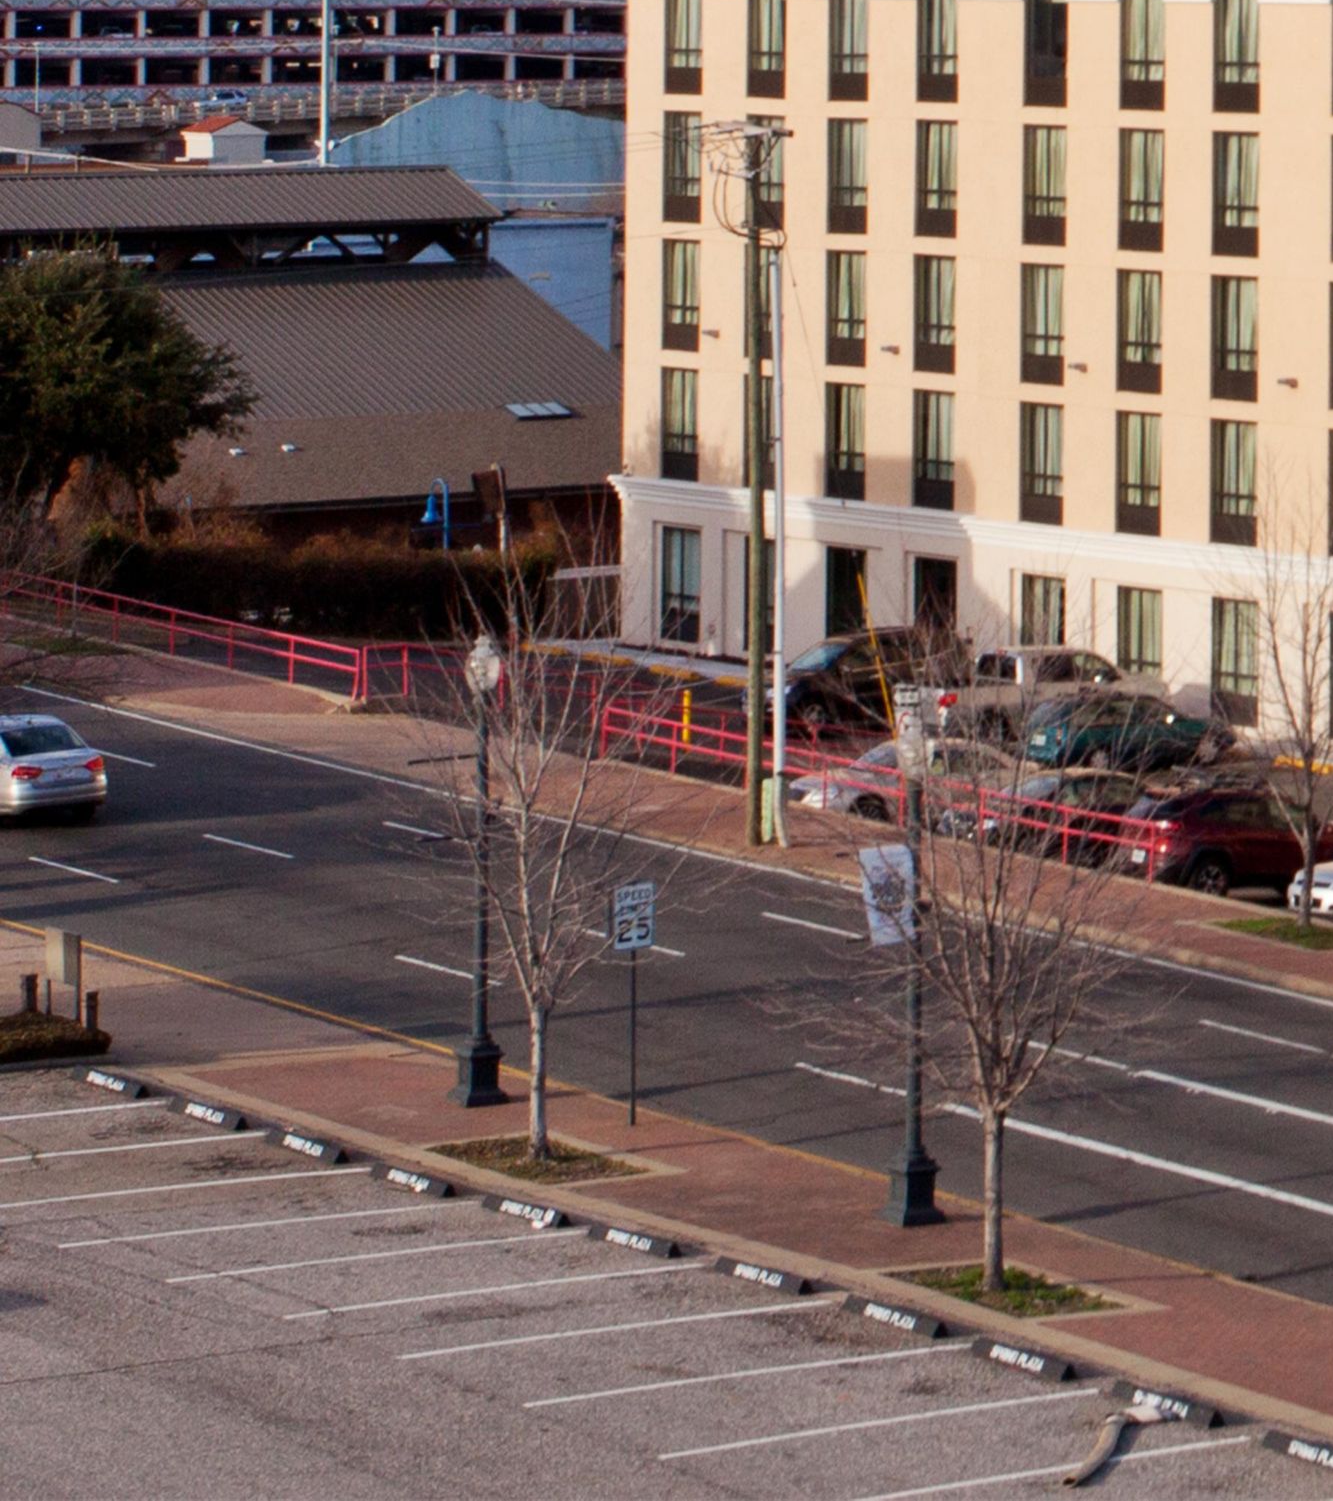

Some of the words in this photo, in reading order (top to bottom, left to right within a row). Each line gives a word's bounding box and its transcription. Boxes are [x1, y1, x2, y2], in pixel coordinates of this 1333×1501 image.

[617, 888, 651, 904] SPEED
[617, 916, 650, 943] 25
[757, 1269, 783, 1287] PLAZA
[888, 1311, 916, 1330] PLAZA
[1287, 1440, 1320, 1462] SPRING
